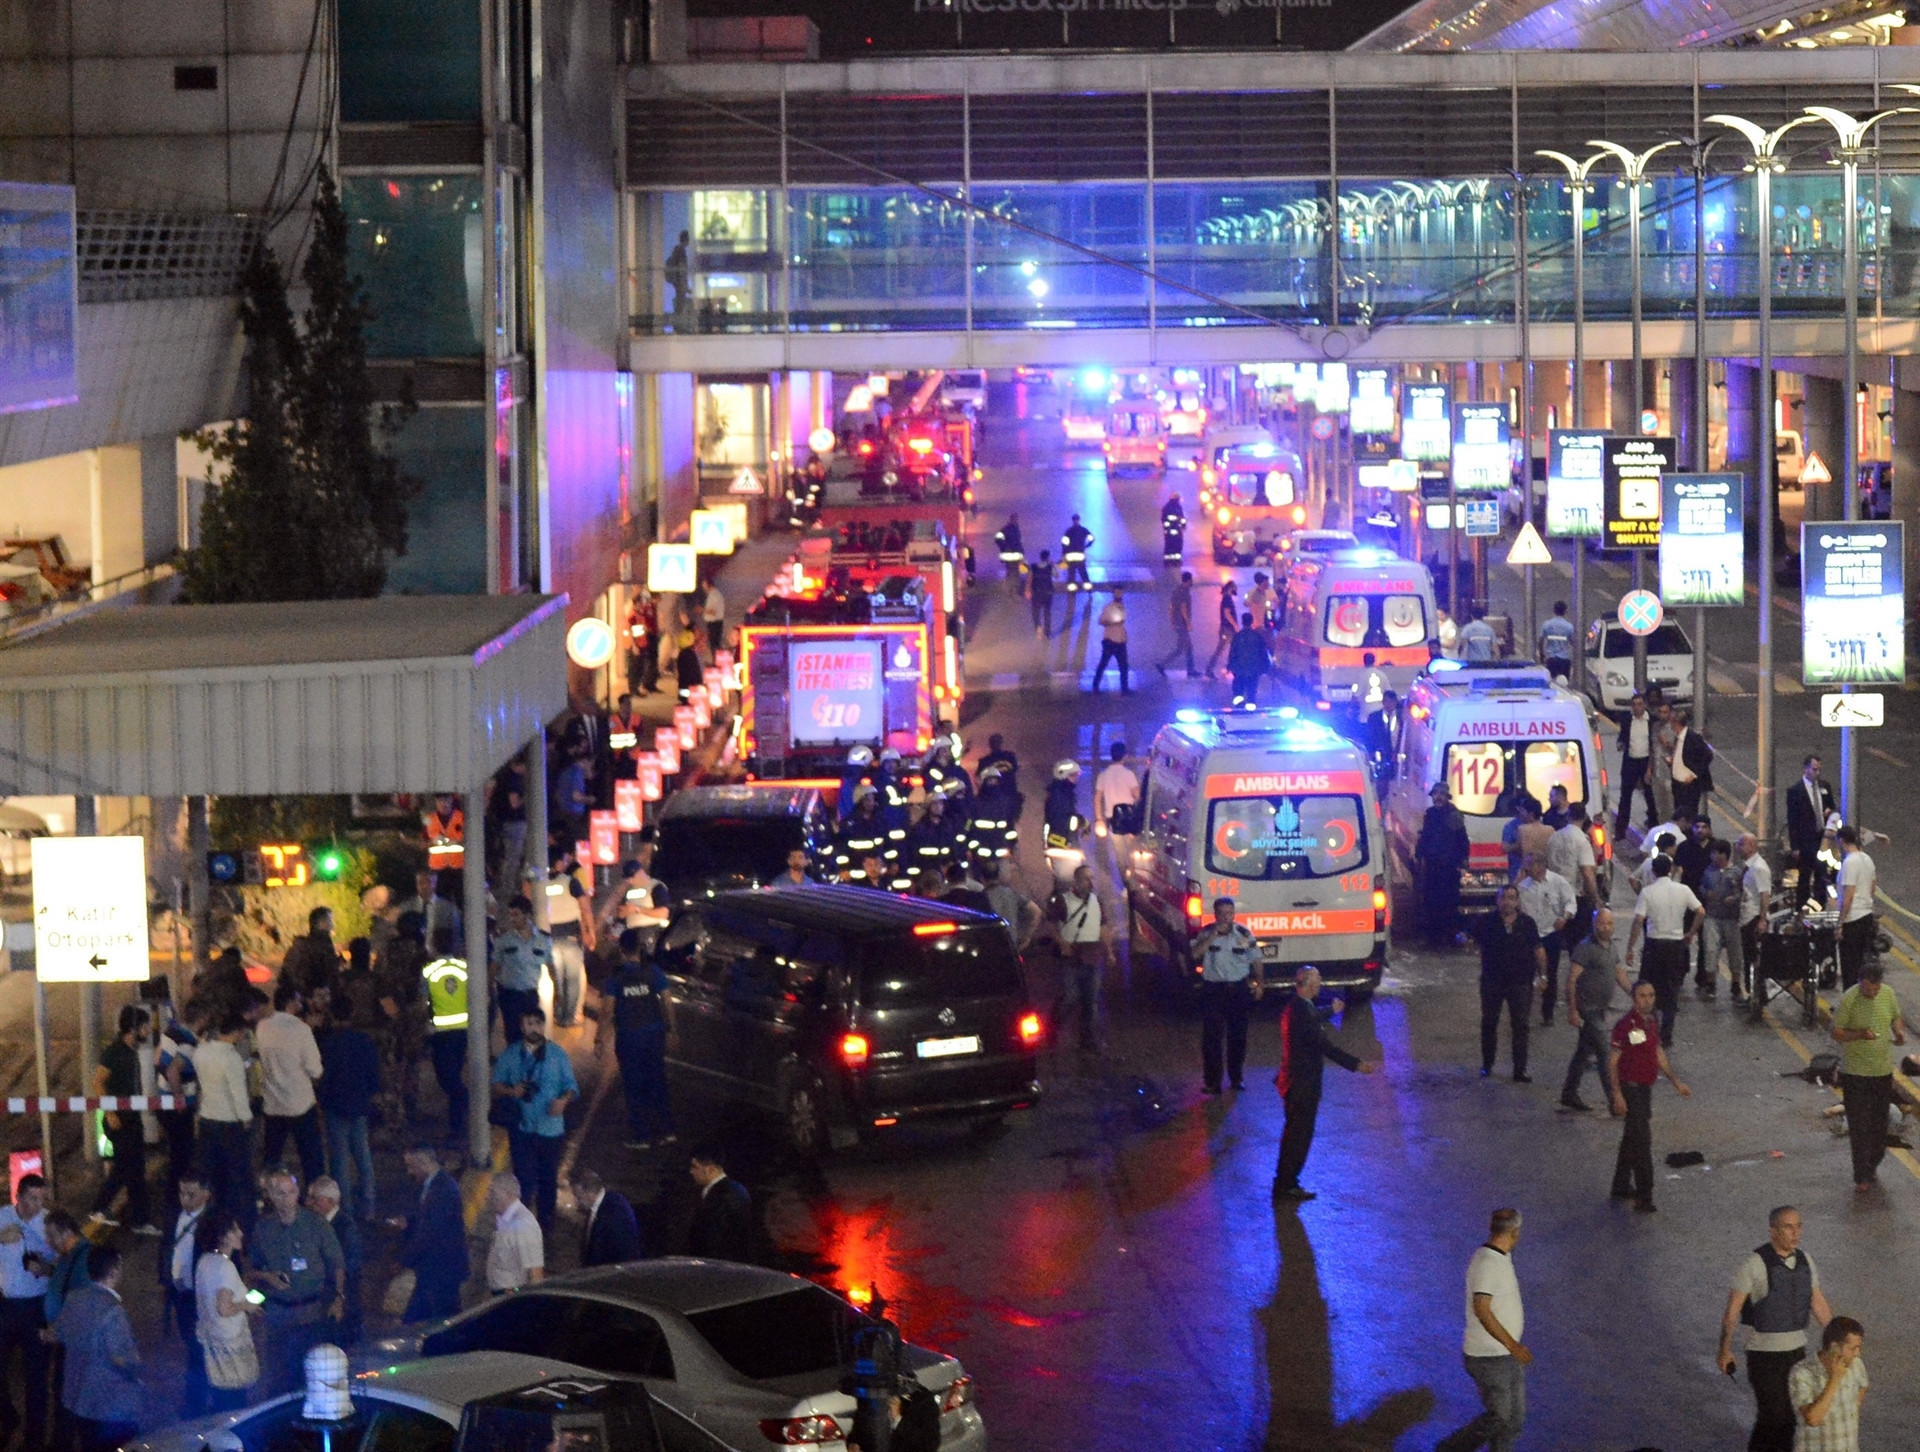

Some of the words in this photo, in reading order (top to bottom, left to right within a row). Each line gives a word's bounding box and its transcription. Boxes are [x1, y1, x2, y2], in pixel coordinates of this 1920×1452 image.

[1458, 721, 1566, 736] AMBULANS
[1234, 775, 1330, 793] AMBULANS
[1453, 758, 1499, 795] 112
[1207, 878, 1240, 896] 112
[1340, 873, 1371, 892] 112
[1247, 916, 1289, 931] HIZIR
[1292, 912, 1326, 930] ACİL
